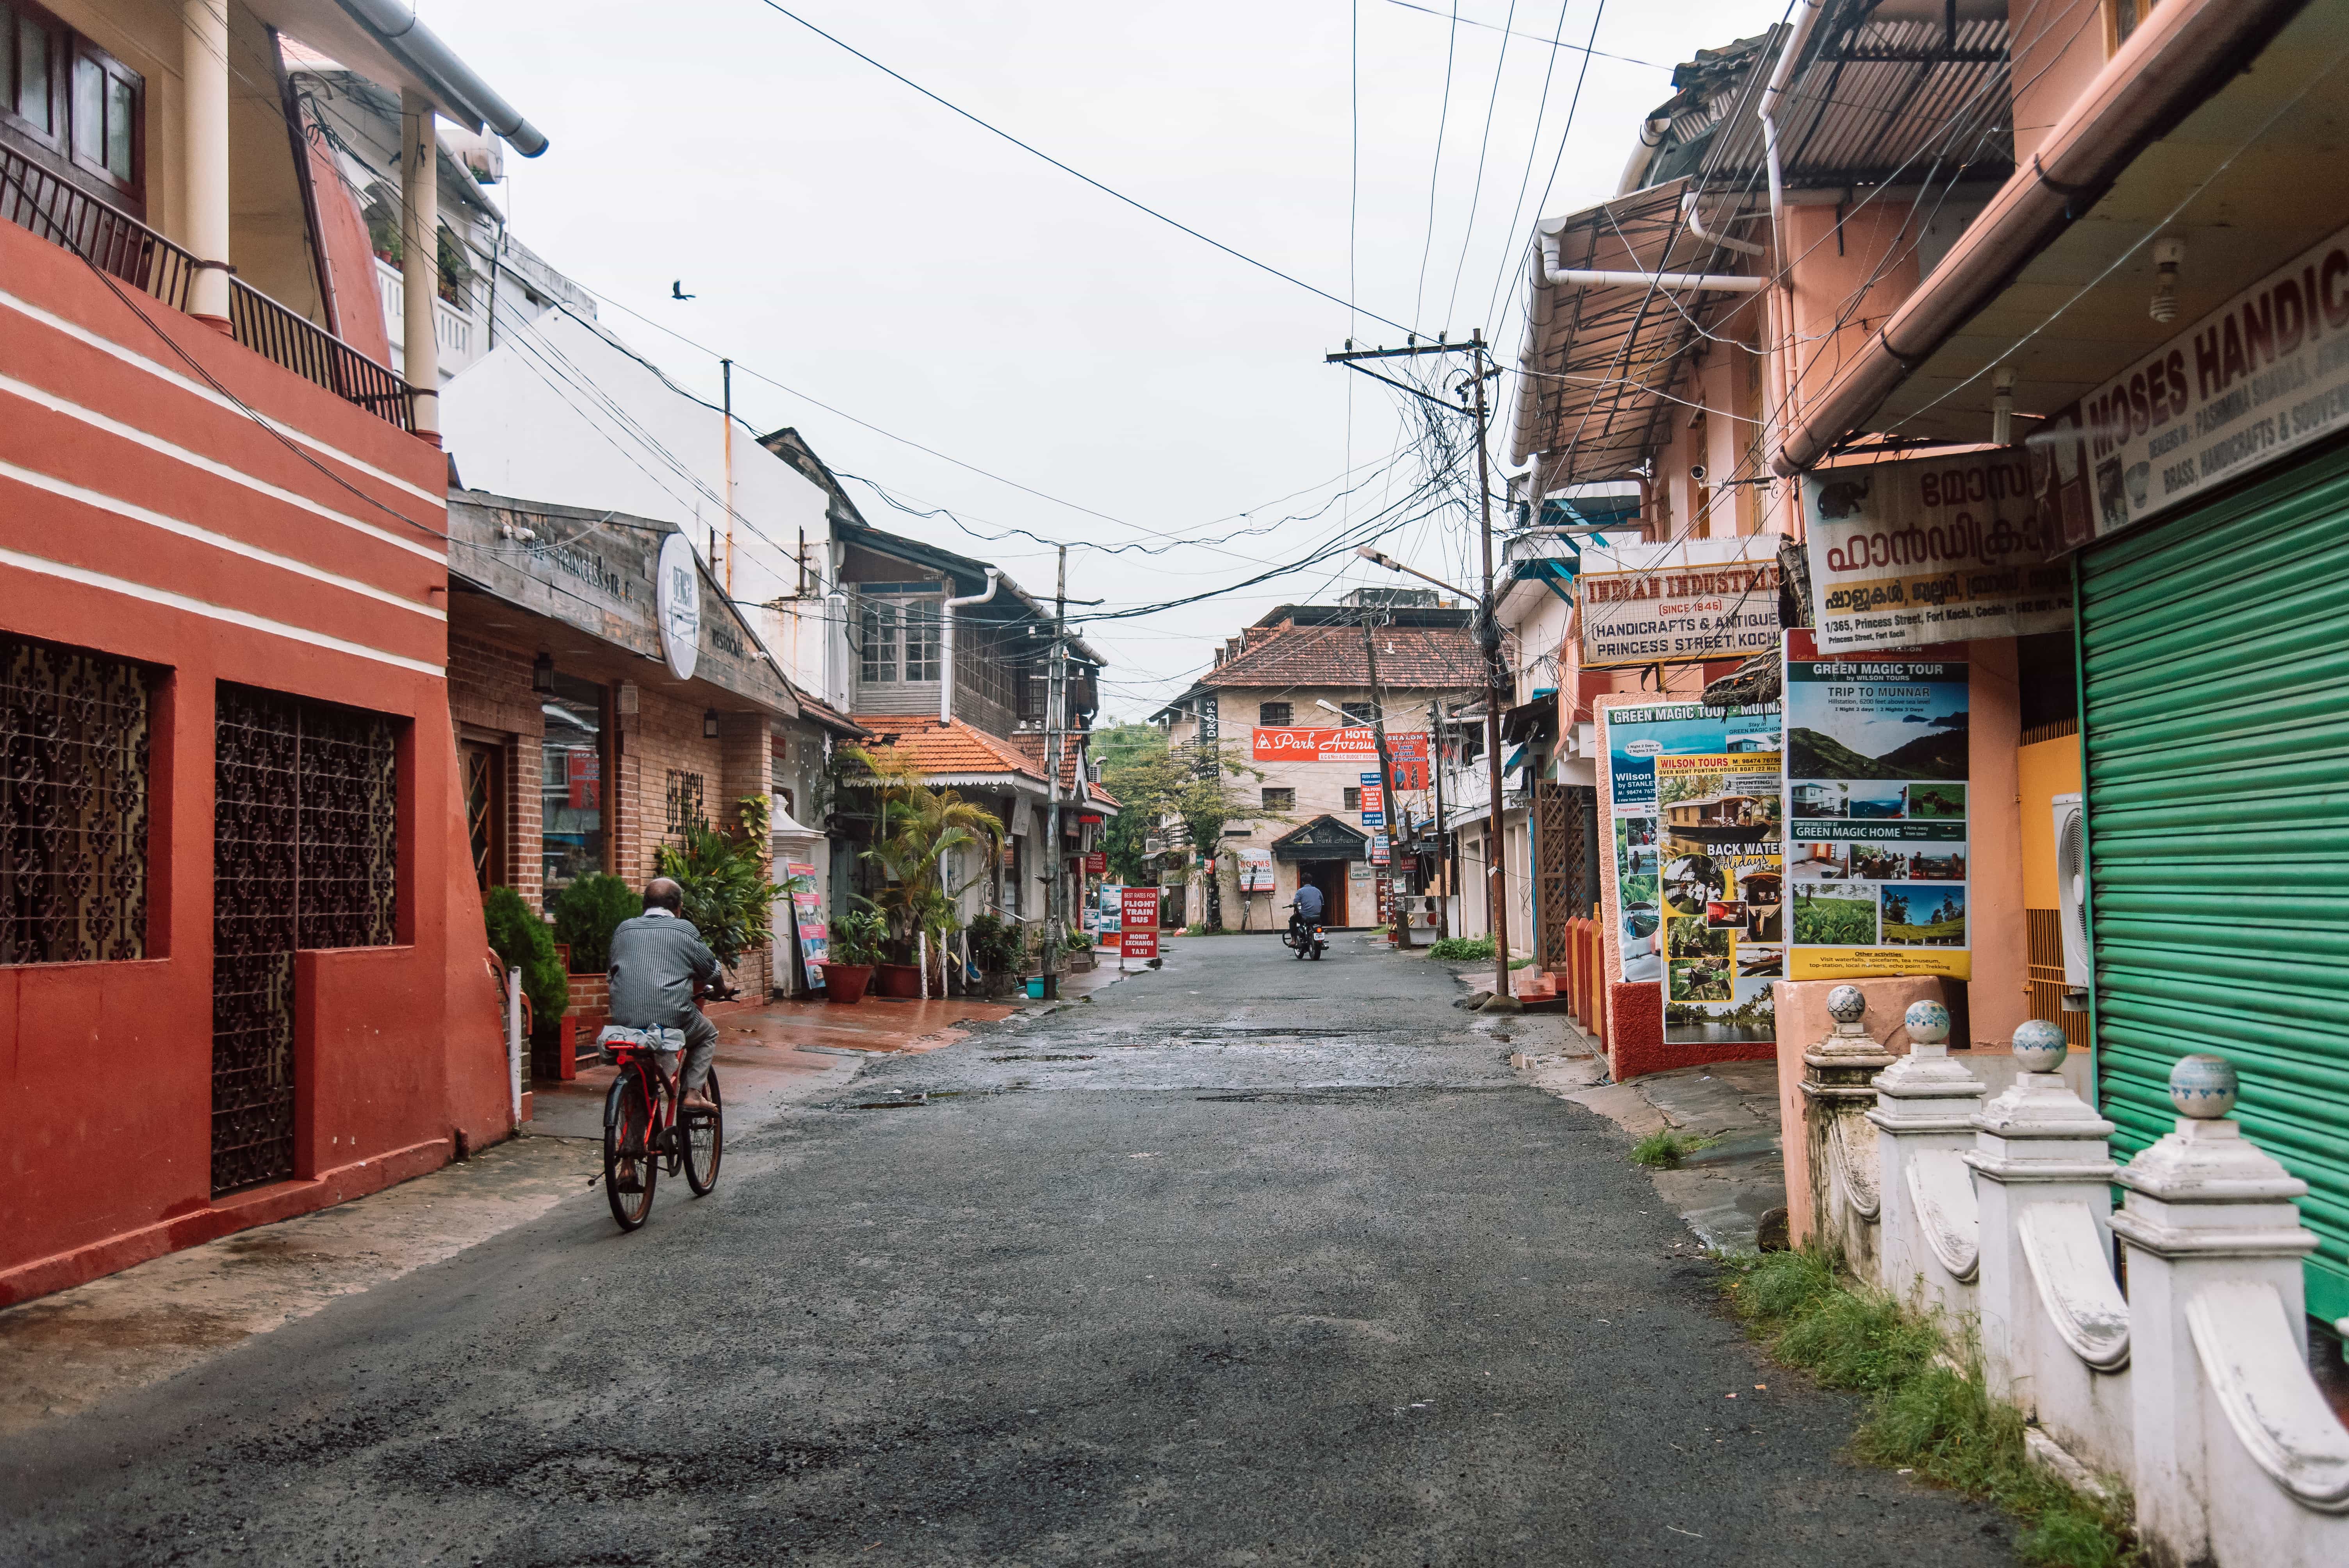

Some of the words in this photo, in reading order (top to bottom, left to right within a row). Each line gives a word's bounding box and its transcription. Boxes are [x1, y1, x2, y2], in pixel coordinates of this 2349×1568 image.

[2089, 349, 2188, 459] MOSES
[1921, 463, 2033, 507] മോസ
[558, 547, 604, 588] PRINCESS
[1588, 577, 1661, 603] INDIAN
[1659, 604, 1690, 616] (SINCE
[1592, 618, 1695, 641] (HANDICRAFTS
[1700, 617, 1710, 629] &
[1715, 612, 1778, 629] ANTIQUE
[1825, 620, 1853, 633] 1/365,
[1855, 615, 1892, 630] Princess
[1895, 613, 1924, 626] Street,
[1927, 610, 1944, 622] Fort
[1946, 608, 1973, 620] Kochi,
[1976, 605, 2006, 617] Cochin
[1829, 634, 1853, 644] Princess
[1855, 633, 1874, 642] Street,
[1875, 631, 1887, 640] Fort
[1889, 630, 1905, 639] Kochi
[1598, 639, 1668, 656] PRINCESS
[1813, 664, 1857, 675] GREEN
[1861, 664, 1903, 674] MAGIC
[1907, 665, 1943, 674] TOUR
[1828, 687, 1854, 697] TRIP
[1859, 687, 1874, 697] TO
[1878, 687, 1930, 697] MUNNAR
[1614, 709, 1652, 723] GREEN
[1656, 707, 1694, 720] MAGIC
[1274, 732, 1315, 750] Park
[1345, 730, 1374, 739] HOTE
[1661, 759, 1695, 768] WILSON
[1698, 758, 1728, 767] TOURS
[1796, 827, 1830, 837] GREEN
[1833, 828, 1867, 837] MAGIC
[1869, 828, 1900, 837] HOME
[1707, 843, 1743, 855] BACK
[1711, 852, 1769, 874] Holidays
